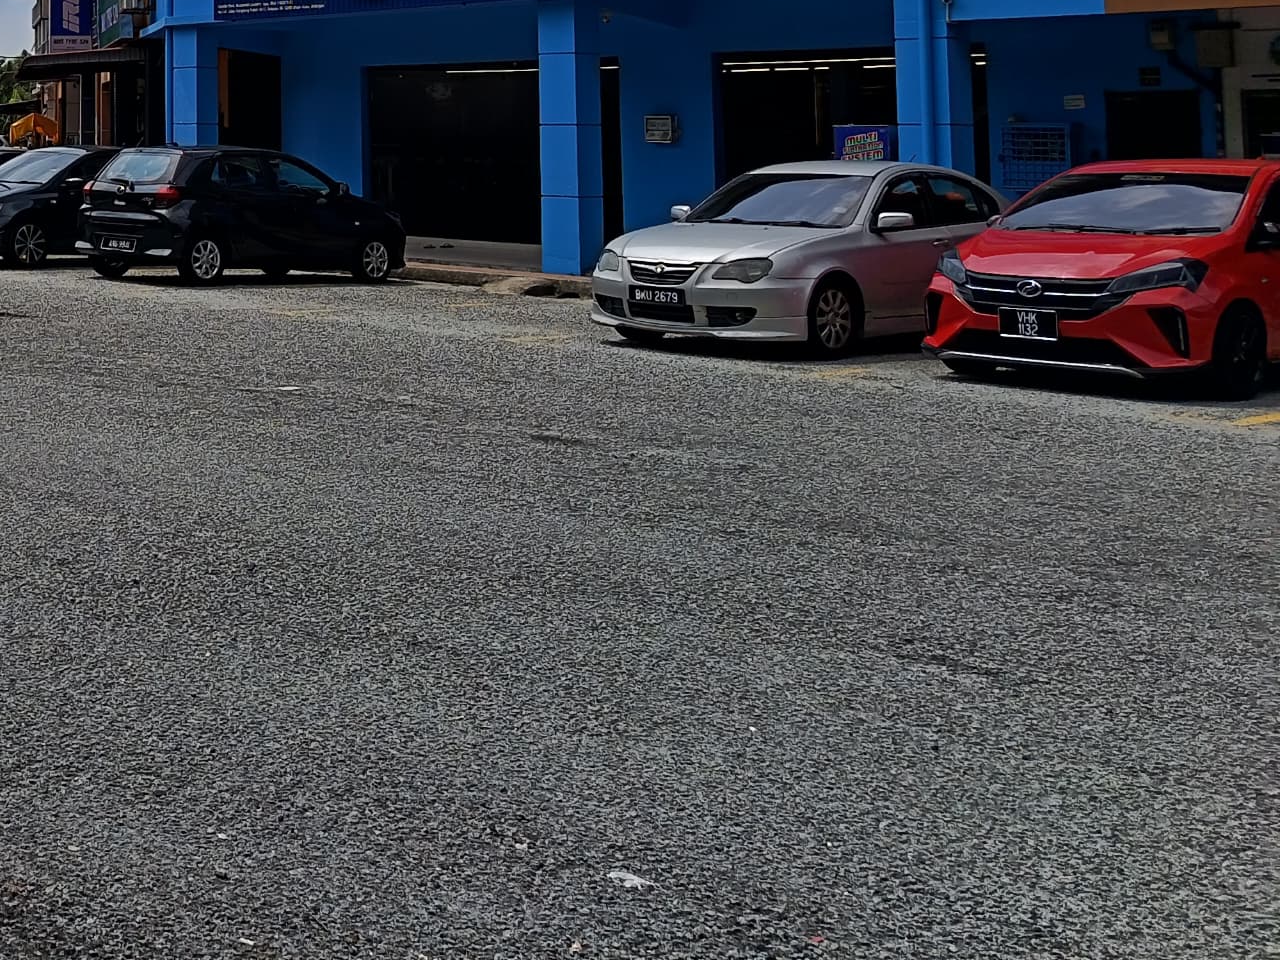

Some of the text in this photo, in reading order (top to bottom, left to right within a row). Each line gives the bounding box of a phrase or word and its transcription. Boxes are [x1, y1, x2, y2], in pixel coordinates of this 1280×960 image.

[845, 131, 878, 146] MULTI
[635, 289, 678, 303] BKU 2679
[1017, 312, 1038, 324] VHK
[1018, 324, 1039, 336] 1132
